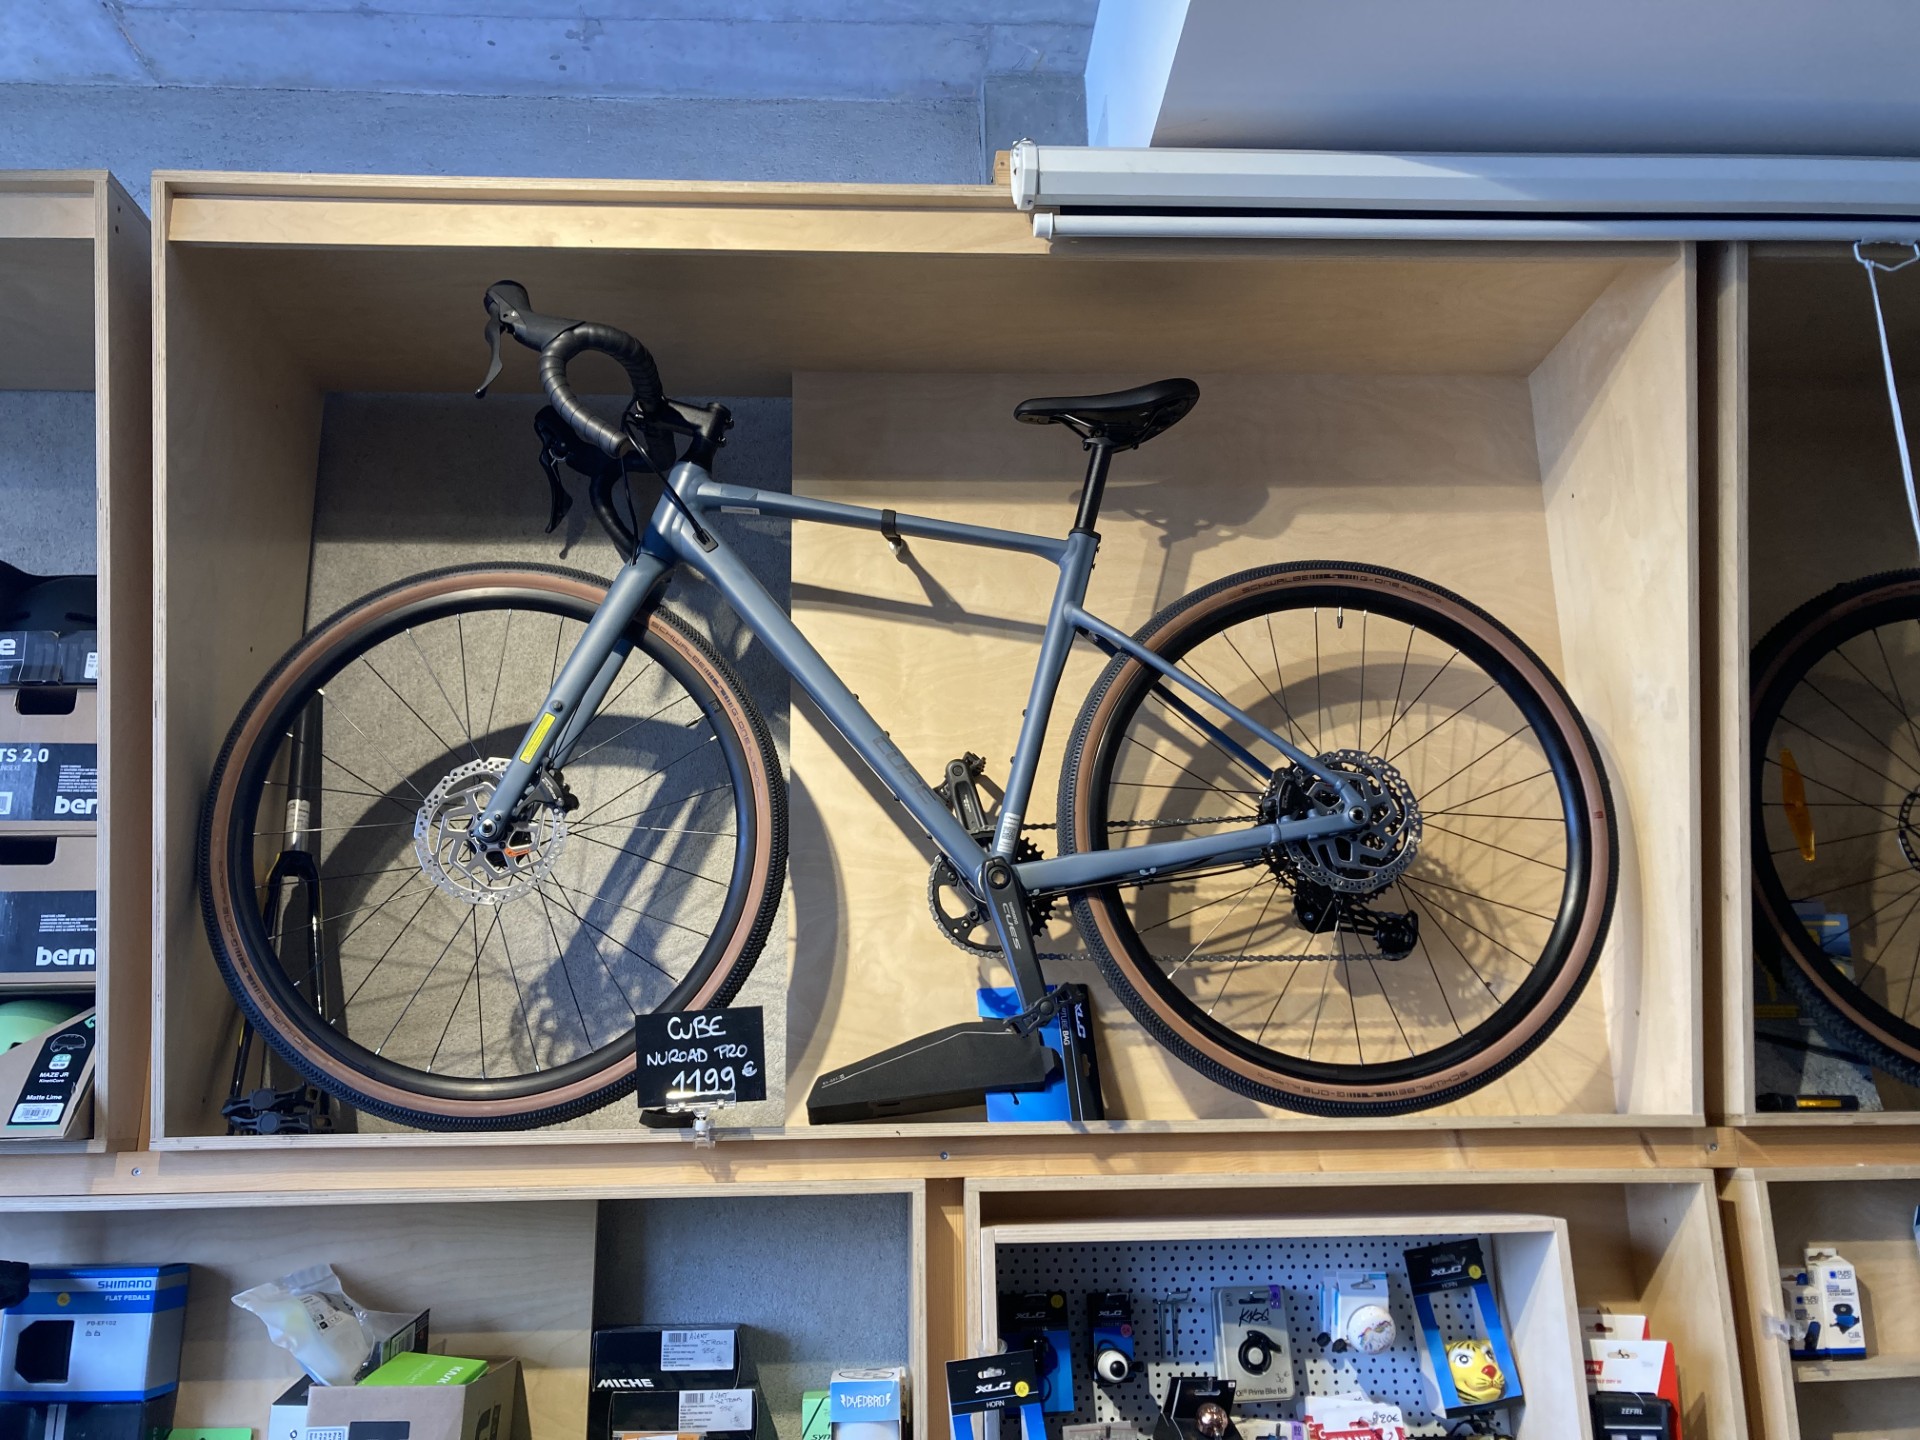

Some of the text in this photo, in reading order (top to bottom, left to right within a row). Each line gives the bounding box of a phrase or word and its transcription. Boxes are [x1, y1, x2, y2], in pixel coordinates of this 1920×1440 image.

[1241, 574, 1309, 593] SCHWALBE
[650, 620, 706, 671] SCHWALBE
[21, 748, 49, 763] 2.0
[54, 795, 97, 815] ber
[1002, 902, 1022, 950] CUES
[35, 946, 96, 967] bern
[257, 992, 311, 1051] SCHWALBE
[667, 1015, 727, 1040] CUBE
[1074, 1002, 1086, 1039] XLC
[1062, 1030, 1071, 1046] BAG
[646, 1044, 748, 1067] NUROAD PRO
[1400, 1070, 1469, 1095] SCHWALBE
[1431, 1265, 1462, 1277] XLC
[97, 1280, 152, 1289] SHIMANO
[597, 1378, 655, 1389] MICHE
[974, 1381, 1012, 1394] XLC
[846, 1394, 885, 1408] DYEDBRO
